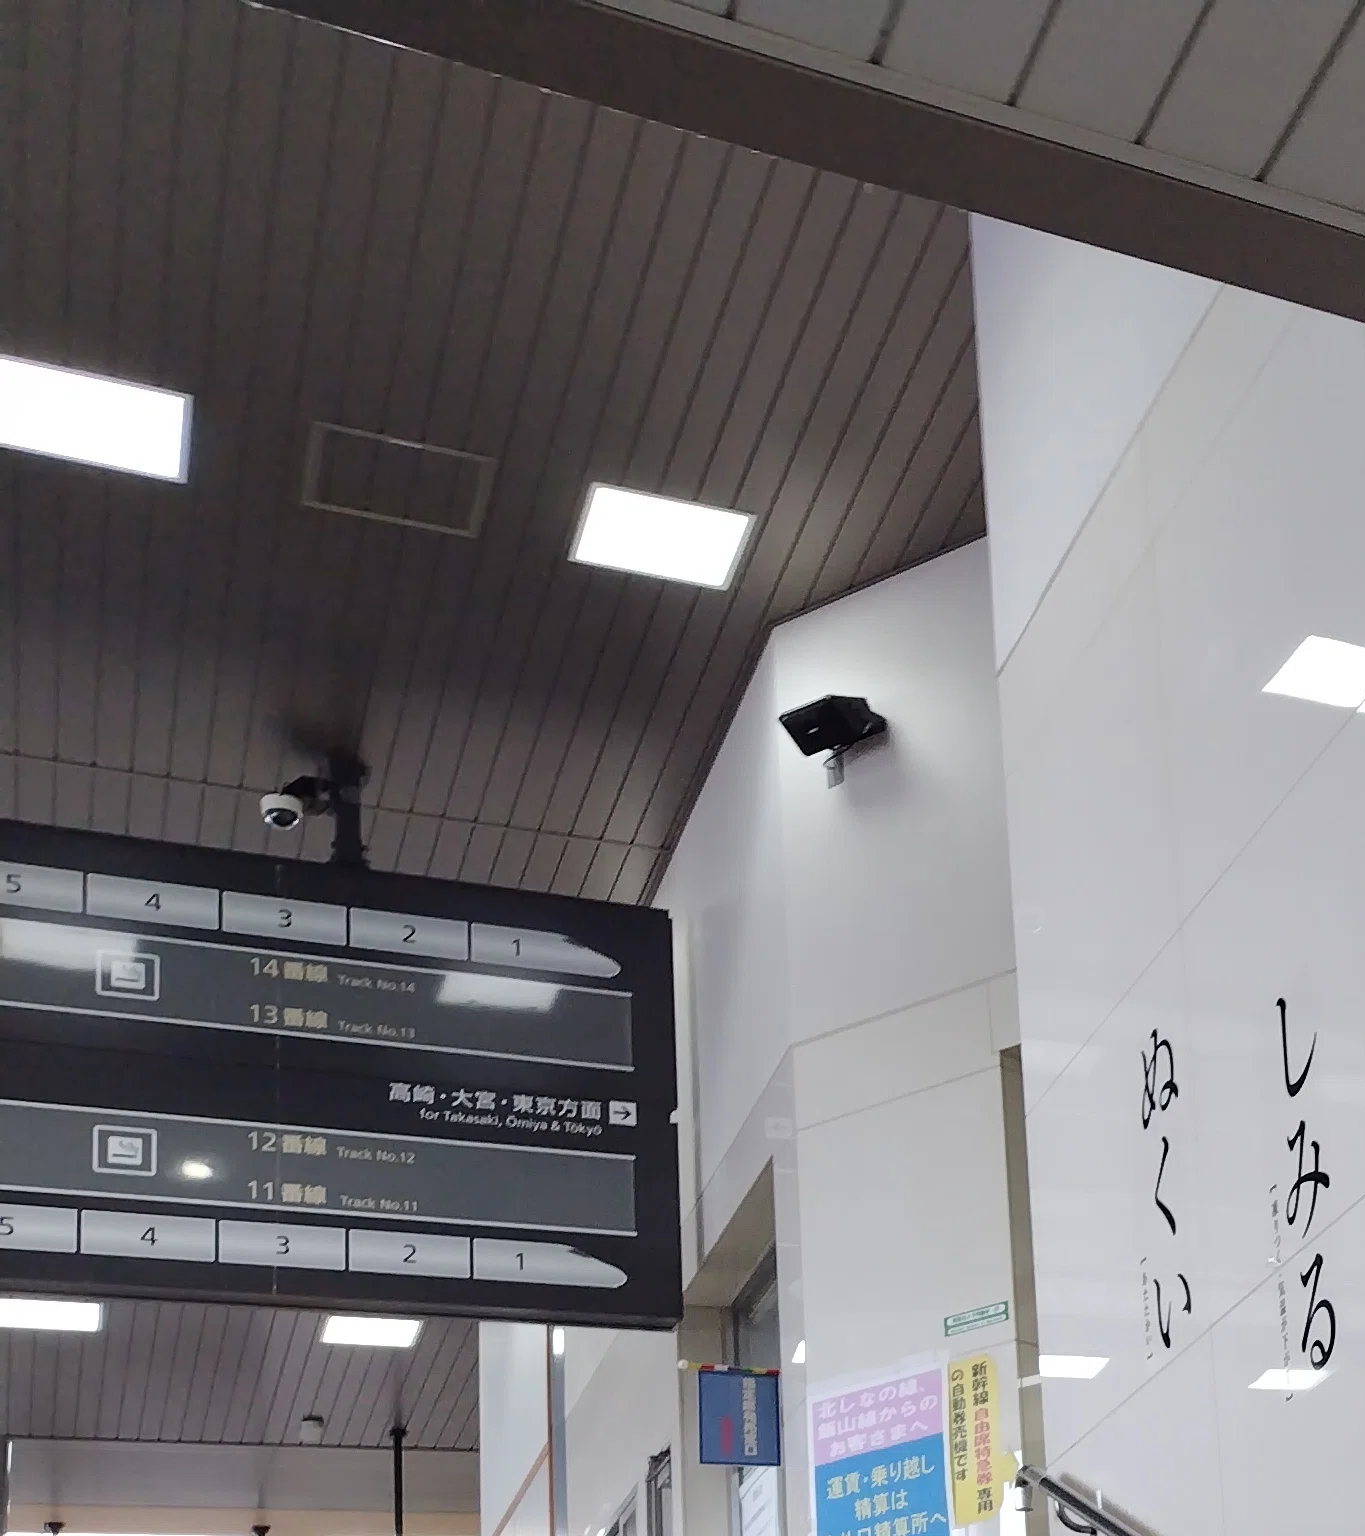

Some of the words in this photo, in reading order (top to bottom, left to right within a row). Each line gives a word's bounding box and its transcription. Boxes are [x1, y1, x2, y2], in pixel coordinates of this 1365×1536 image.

[6, 874, 21, 893] 5
[144, 893, 162, 912] 4
[277, 909, 292, 928] 3
[402, 925, 417, 944] 2
[511, 939, 521, 957] 1
[419, 1107, 440, 1122] for
[550, 1120, 561, 1132] &
[1140, 1027, 1192, 1349] ぬくい
[1275, 997, 1336, 1370] しみる
[140, 1227, 158, 1246] 4
[276, 1236, 290, 1256] 3
[402, 1245, 417, 1265] 2
[515, 1252, 525, 1271] 1
[854, 1488, 909, 1522] 精算は
